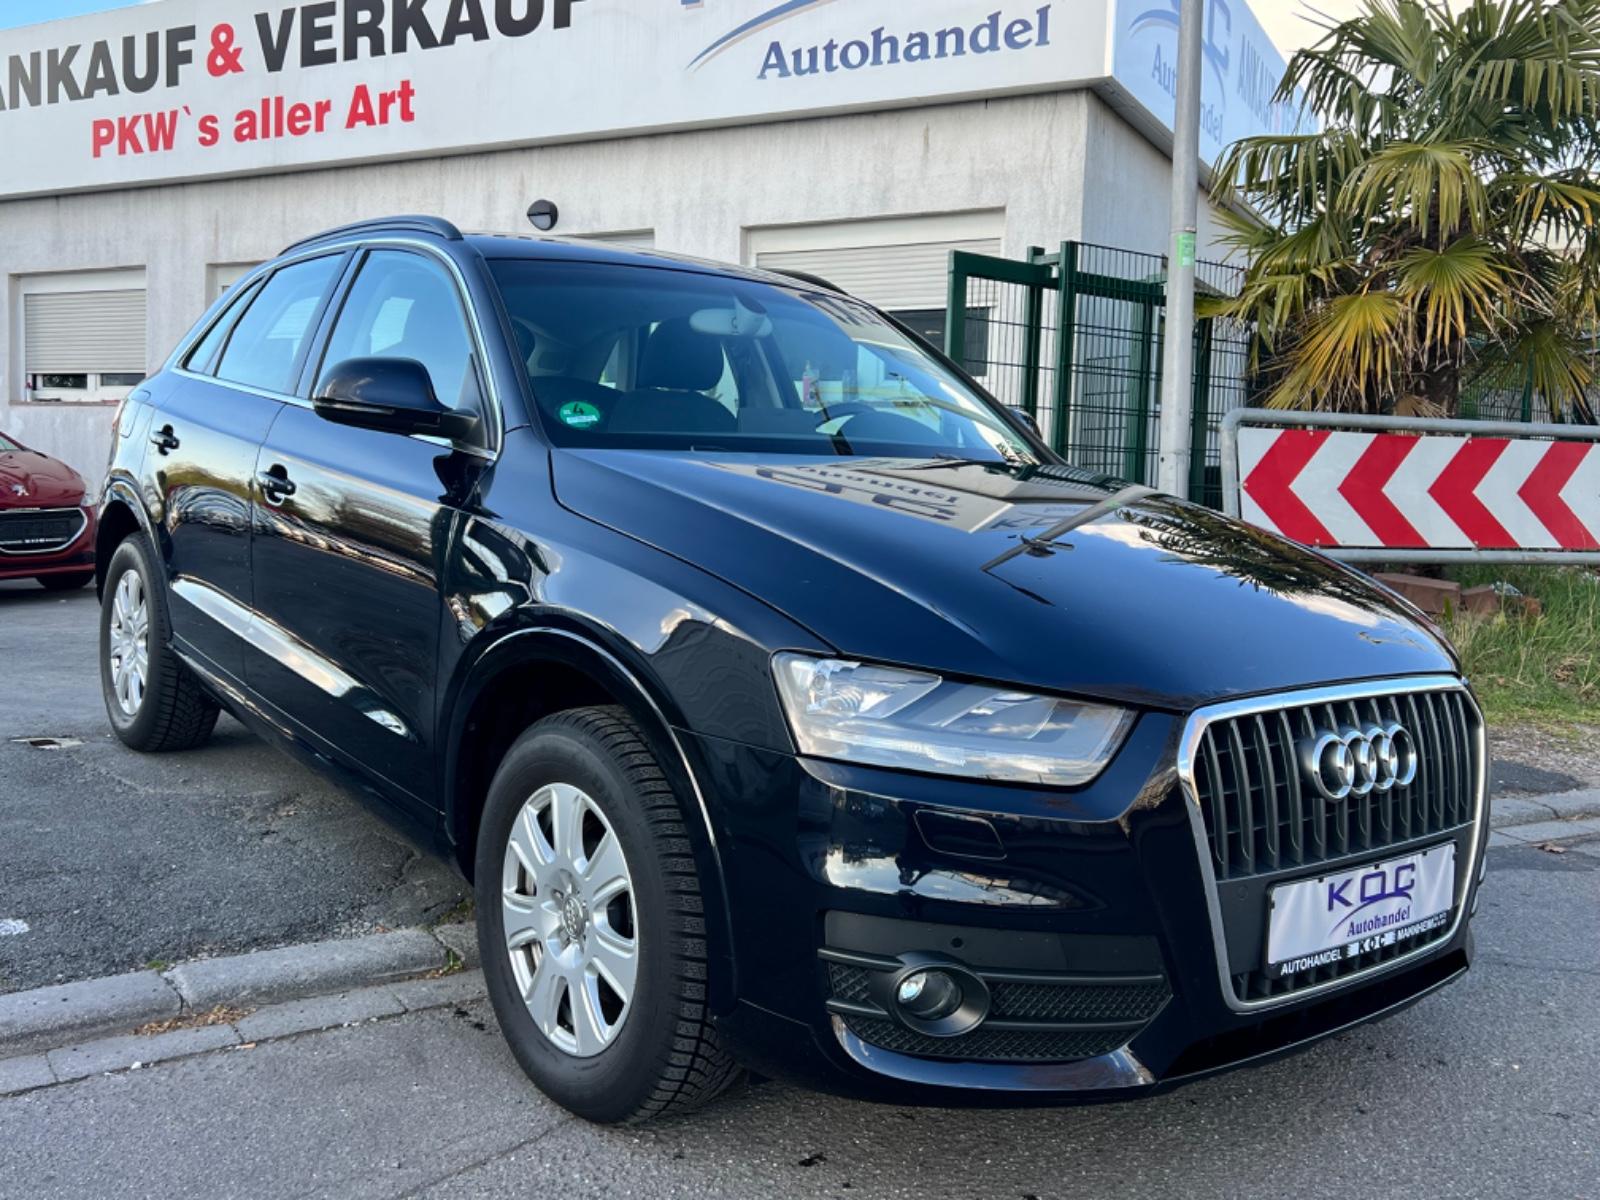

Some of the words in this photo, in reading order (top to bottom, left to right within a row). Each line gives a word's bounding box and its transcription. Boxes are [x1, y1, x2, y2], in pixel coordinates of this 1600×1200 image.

[0, 25, 196, 111] NKAUF
[206, 23, 244, 77] &
[756, 4, 1052, 80] Autohandel
[233, 96, 332, 143] aller
[345, 79, 416, 129] Art
[1152, 43, 1223, 146] Autndel
[1347, 905, 1410, 937] Autohandel
[1280, 948, 1342, 976] AUTOHANDEL
